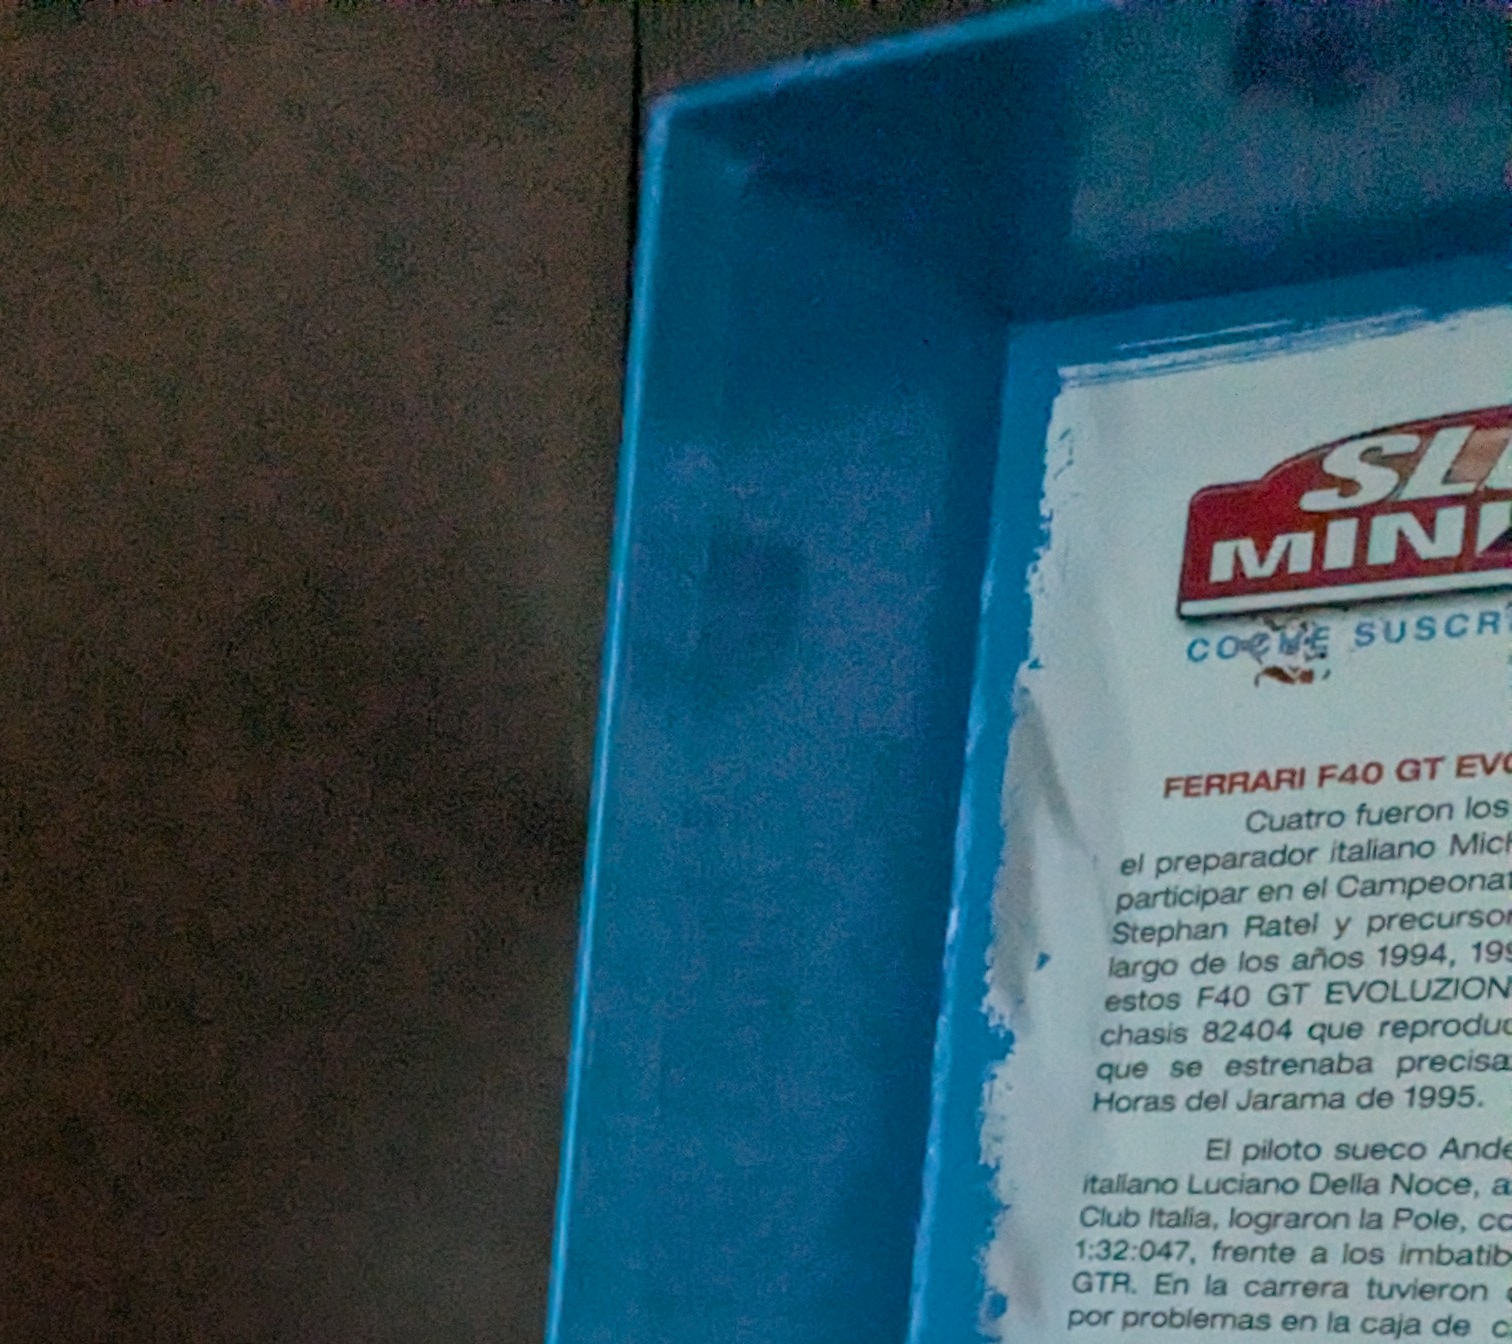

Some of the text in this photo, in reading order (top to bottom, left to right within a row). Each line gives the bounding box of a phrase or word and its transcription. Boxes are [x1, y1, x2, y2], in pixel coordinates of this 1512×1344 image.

[1163, 767, 1306, 799] FERRARI
[1318, 761, 1385, 789] F40
[1395, 756, 1445, 783] GT
[1246, 796, 1509, 834] Cuatro fueron los
[1120, 854, 1144, 877] el
[1155, 843, 1319, 879] preparador
[1330, 837, 1435, 864] italiano
[1115, 882, 1249, 915] participar
[1257, 884, 1293, 904] en
[1303, 877, 1328, 900] el
[1112, 919, 1228, 949] Stephan
[1244, 912, 1318, 938] Ratel
[1334, 916, 1352, 940] y
[1108, 954, 1178, 983] largo
[1190, 951, 1227, 975] de
[1238, 950, 1279, 974] los
[1291, 946, 1365, 970] años
[1379, 942, 1457, 969] 1994,
[1104, 989, 1181, 1013] estos
[1196, 985, 1251, 1009] F40
[1267, 982, 1311, 1006] GT
[1100, 1020, 1189, 1047] chasis
[1202, 1018, 1293, 1043] 82404
[1307, 1019, 1363, 1046] que
[1096, 1058, 1149, 1083] que
[1170, 1059, 1203, 1078] se
[1225, 1051, 1374, 1078] estrenaba
[1092, 1084, 1484, 1114] Horas del Jarama de 1995.
[1206, 1138, 1232, 1161] El
[1242, 1137, 1322, 1166] piloto
[1334, 1141, 1427, 1161] sueco
[1082, 1172, 1179, 1196] italiano
[1188, 1173, 1300, 1196] Luciano
[1309, 1172, 1381, 1196] Della
[1389, 1172, 1479, 1198] Noce,
[1079, 1205, 1141, 1229] Club
[1149, 1205, 1218, 1231] Italia,
[1228, 1206, 1351, 1235] lograron
[1359, 1206, 1383, 1231] la
[1392, 1207, 1466, 1233] Pole,
[1211, 1240, 1296, 1264] frente
[1310, 1246, 1329, 1265] a
[1343, 1241, 1384, 1265] los
[1072, 1271, 1136, 1295] GTR.
[1154, 1272, 1190, 1296] En
[1205, 1273, 1228, 1297] la
[1244, 1278, 1350, 1299] carrera
[1366, 1277, 1488, 1302] tuvieron
[1067, 1309, 1115, 1331] por
[1121, 1308, 1271, 1332] problemas
[1281, 1314, 1318, 1332] en
[1327, 1310, 1350, 1334] la
[1360, 1313, 1422, 1339] caja
[1432, 1314, 1471, 1338] de
